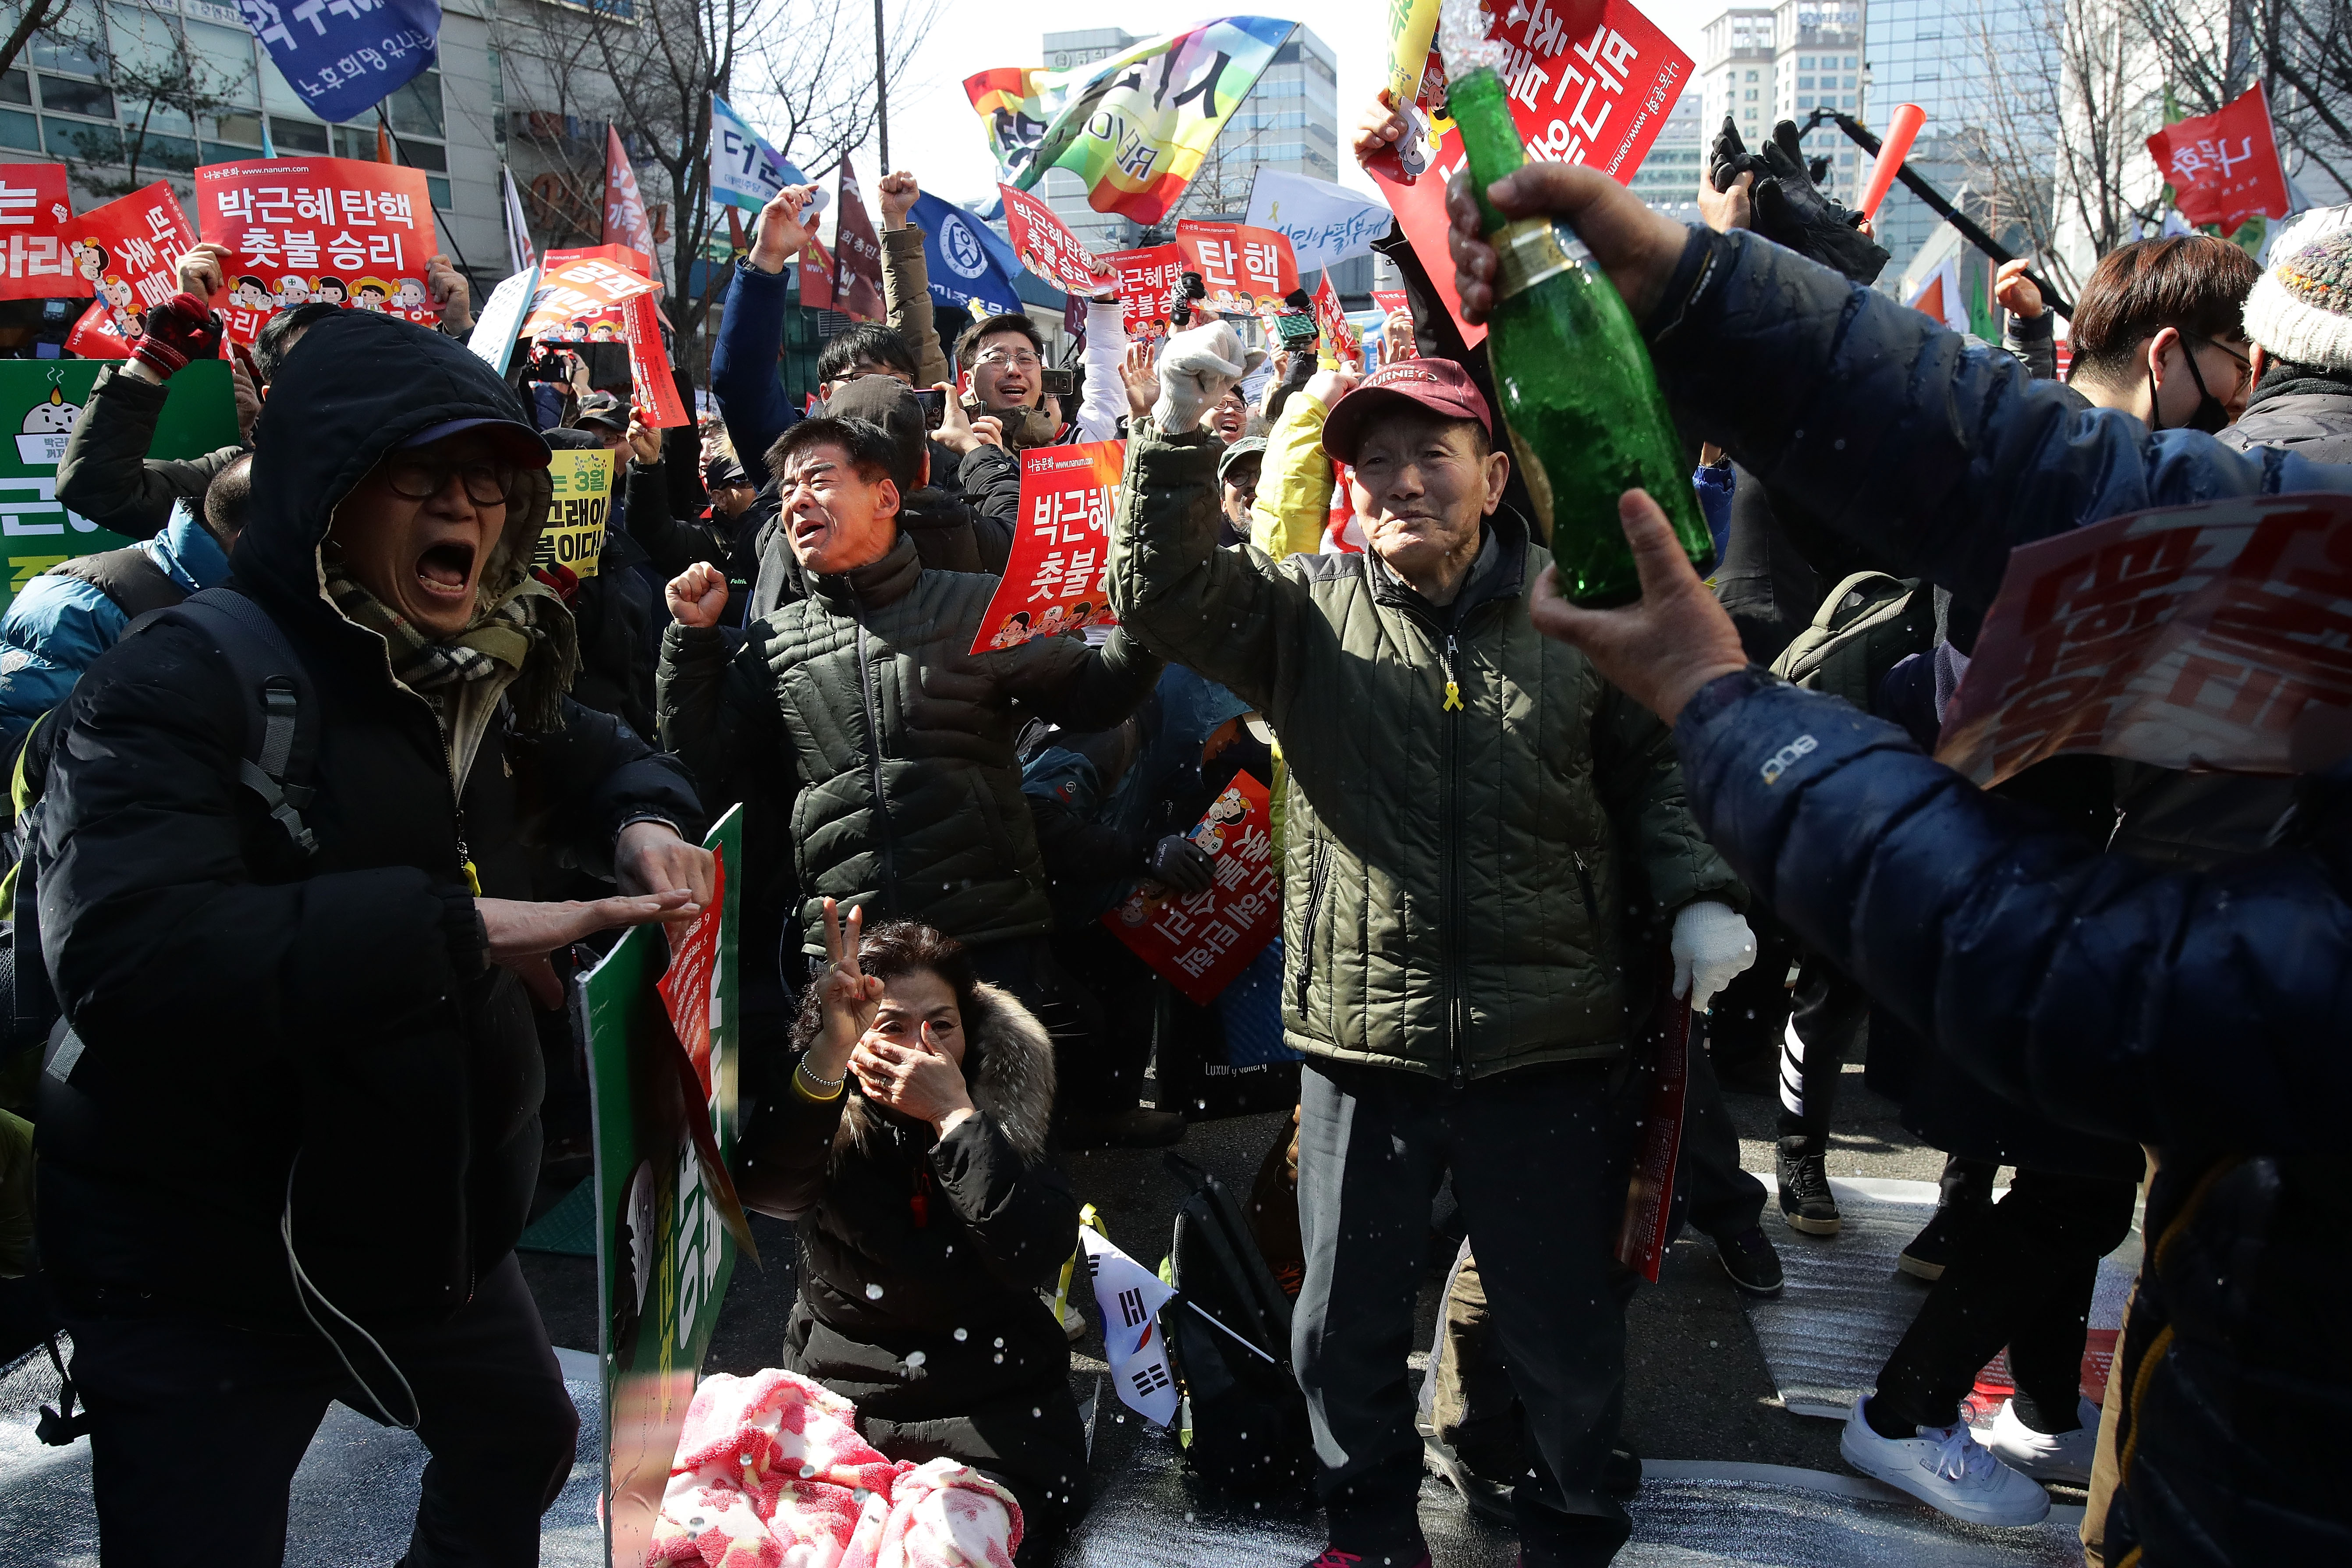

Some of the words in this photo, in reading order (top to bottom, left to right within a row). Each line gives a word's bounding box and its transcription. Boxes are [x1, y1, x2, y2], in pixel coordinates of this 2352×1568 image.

[298, 47, 387, 97] 노후희망
[1648, 60, 1680, 117] 나눔문화
[1603, 106, 1649, 177] www.nanum.
[203, 167, 240, 180] 나눔문화
[241, 166, 309, 175] www.nanum.com
[218, 187, 336, 226] 박근혜
[341, 190, 414, 230] 탄핵
[1013, 200, 1064, 251] 박근혜
[1064, 234, 1093, 270] 탄핵
[239, 228, 321, 269] 촛불
[327, 230, 404, 271] 승리
[1027, 227, 1057, 269] 촛불
[1059, 255, 1095, 287] 승리
[1116, 253, 1153, 262] www.nanum.com
[1196, 240, 1279, 293] 탄핵
[1119, 292, 1156, 319] 촛불
[1027, 456, 1054, 473] 나눔문화
[1055, 457, 1094, 469] www.nanum.com
[1033, 484, 1111, 546] 박근혜
[1027, 547, 1096, 603] 촛불
[1216, 824, 1271, 893] 촛불
[1152, 888, 1222, 945] 승리
[1223, 865, 1279, 931] 근혜
[1172, 919, 1238, 979] 탄핵
